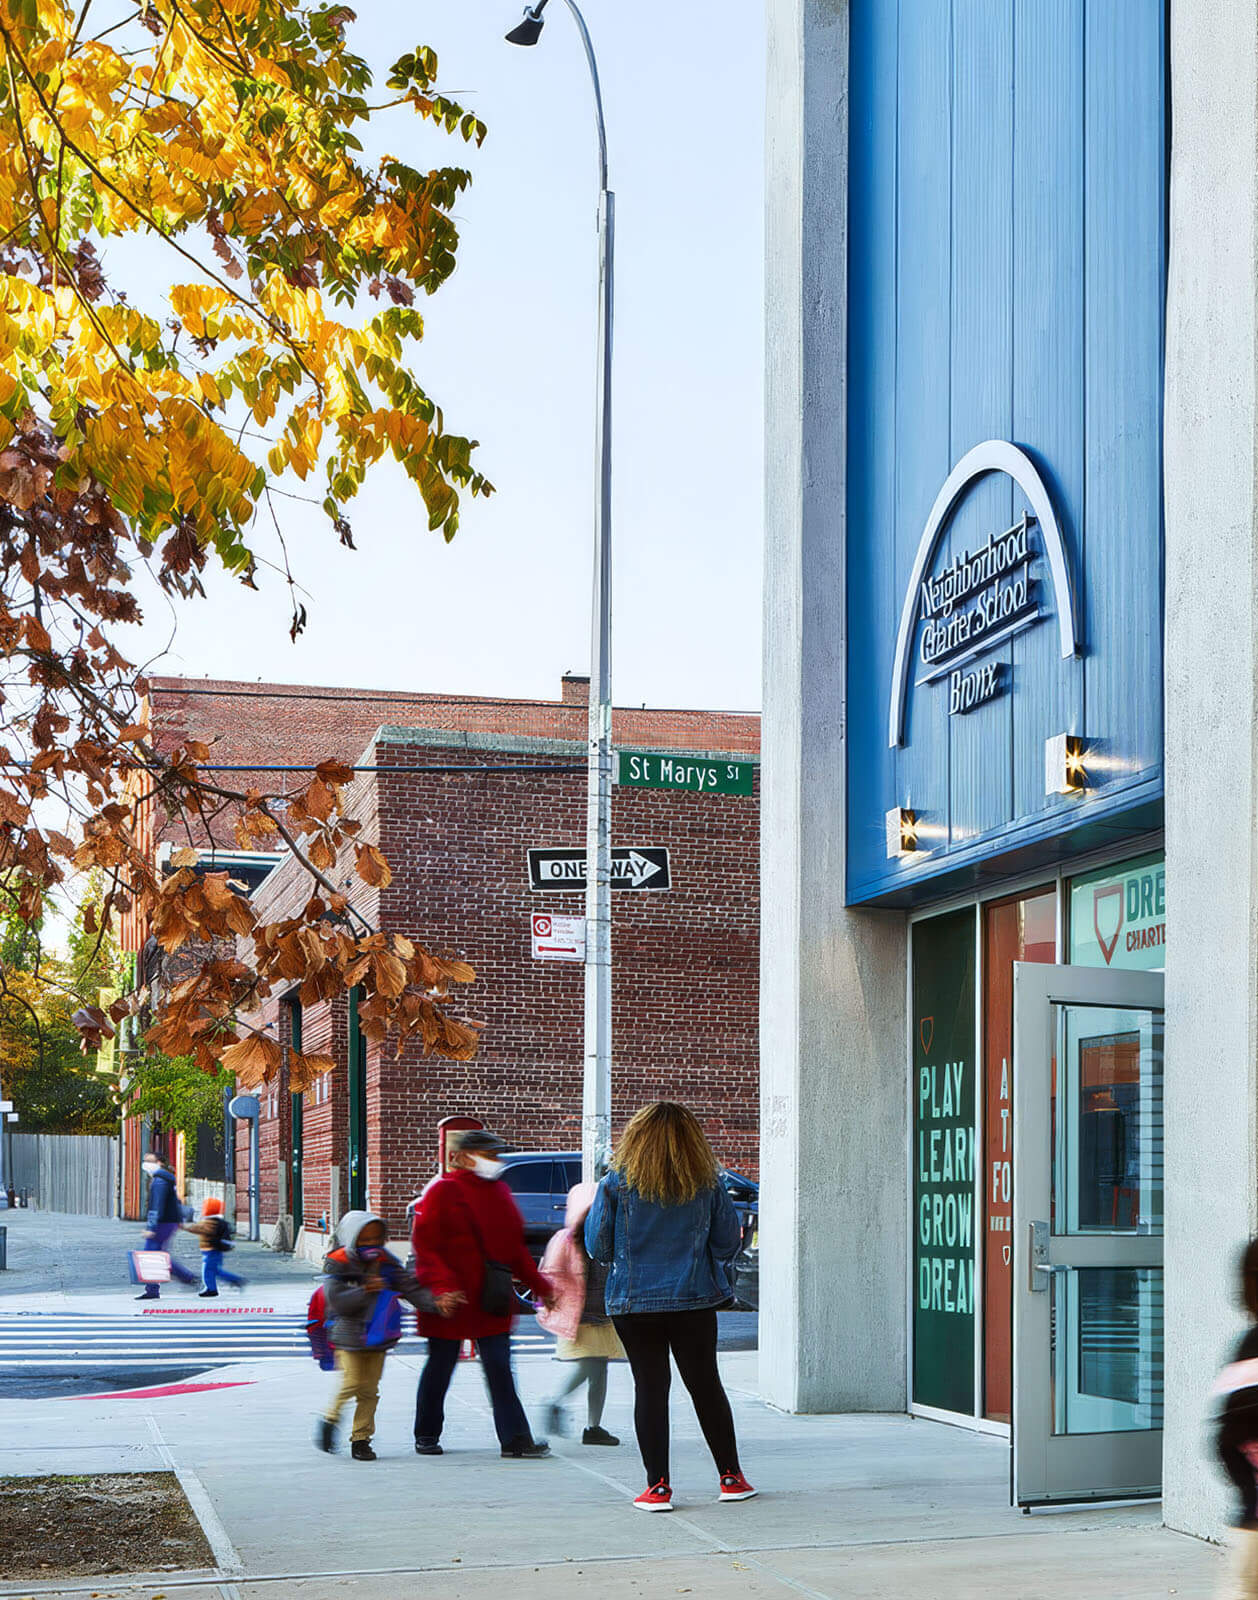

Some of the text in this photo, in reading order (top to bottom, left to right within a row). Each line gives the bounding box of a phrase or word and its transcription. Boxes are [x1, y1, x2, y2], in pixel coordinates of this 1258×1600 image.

[920, 509, 1029, 620] Neighborhood
[920, 560, 1029, 664] Charter School
[948, 662, 999, 715] Bronx
[629, 756, 650, 781] St
[660, 759, 718, 791] Marys
[920, 1061, 964, 1120] PLAY
[919, 1193, 972, 1247] GROW
